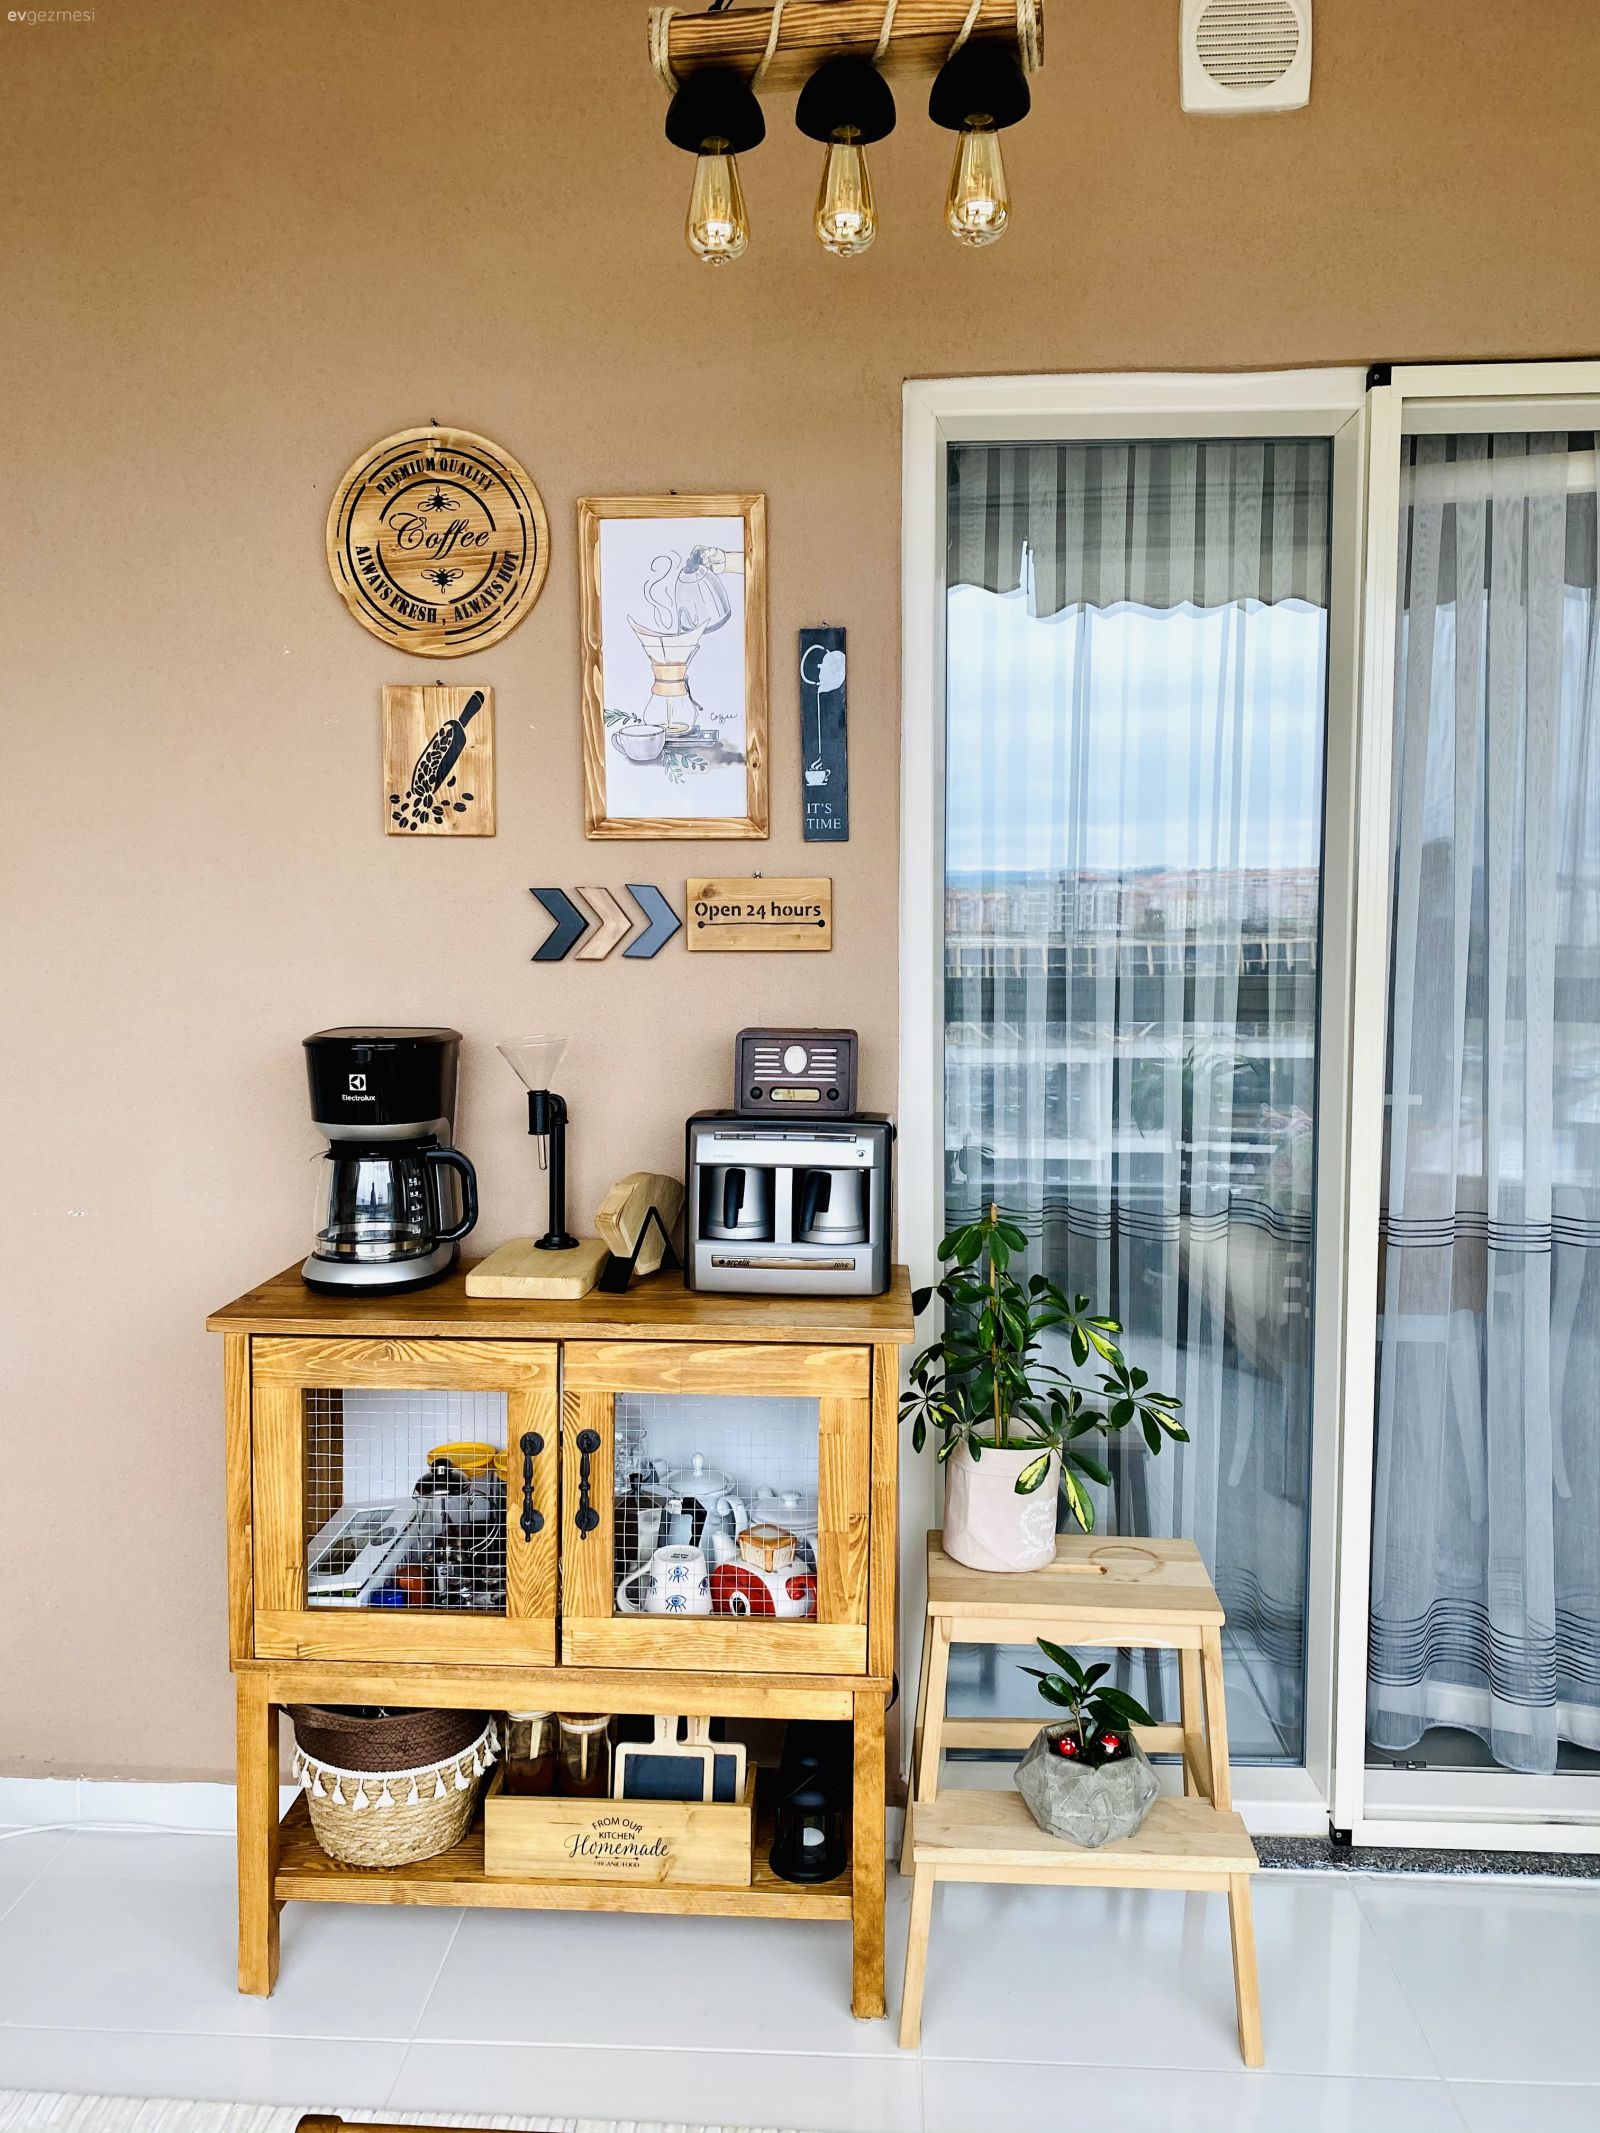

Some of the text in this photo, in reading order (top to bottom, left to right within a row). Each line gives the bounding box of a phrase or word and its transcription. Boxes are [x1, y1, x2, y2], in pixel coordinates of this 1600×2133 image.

[376, 457, 495, 496] PREMIUM QUALITY
[389, 512, 490, 560] Coffee
[356, 546, 393, 600] ALWAYS
[454, 581, 504, 622] ALWAYS
[502, 551, 519, 583] HOT
[807, 803, 832, 814] IT'S
[806, 818, 841, 830] TIME
[695, 901, 821, 920] Open 24 hours
[341, 1094, 376, 1102] Electrolux
[592, 1817, 643, 1833] FROM OUR
[599, 1832, 635, 1840] KITCHEN
[564, 1833, 669, 1857] Homemade
